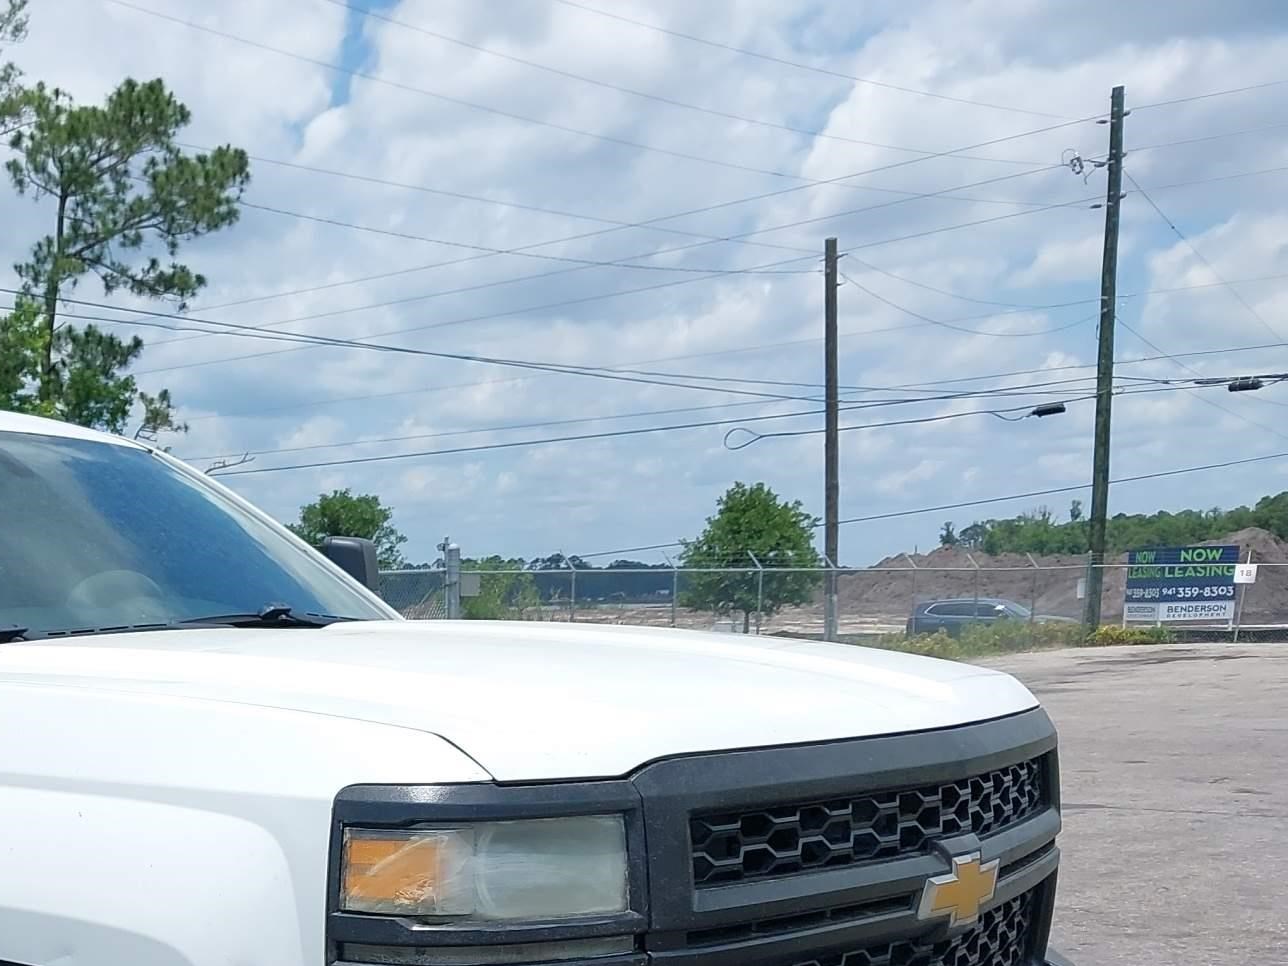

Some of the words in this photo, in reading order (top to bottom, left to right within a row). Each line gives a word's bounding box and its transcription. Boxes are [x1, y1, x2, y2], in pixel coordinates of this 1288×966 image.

[1136, 551, 1156, 563] NOW
[1180, 548, 1223, 562] NOW
[1164, 566, 1234, 577] LEASING
[1240, 569, 1252, 577] 18
[1177, 586, 1234, 598] 359-8303
[1167, 604, 1226, 614] BENDERSON
